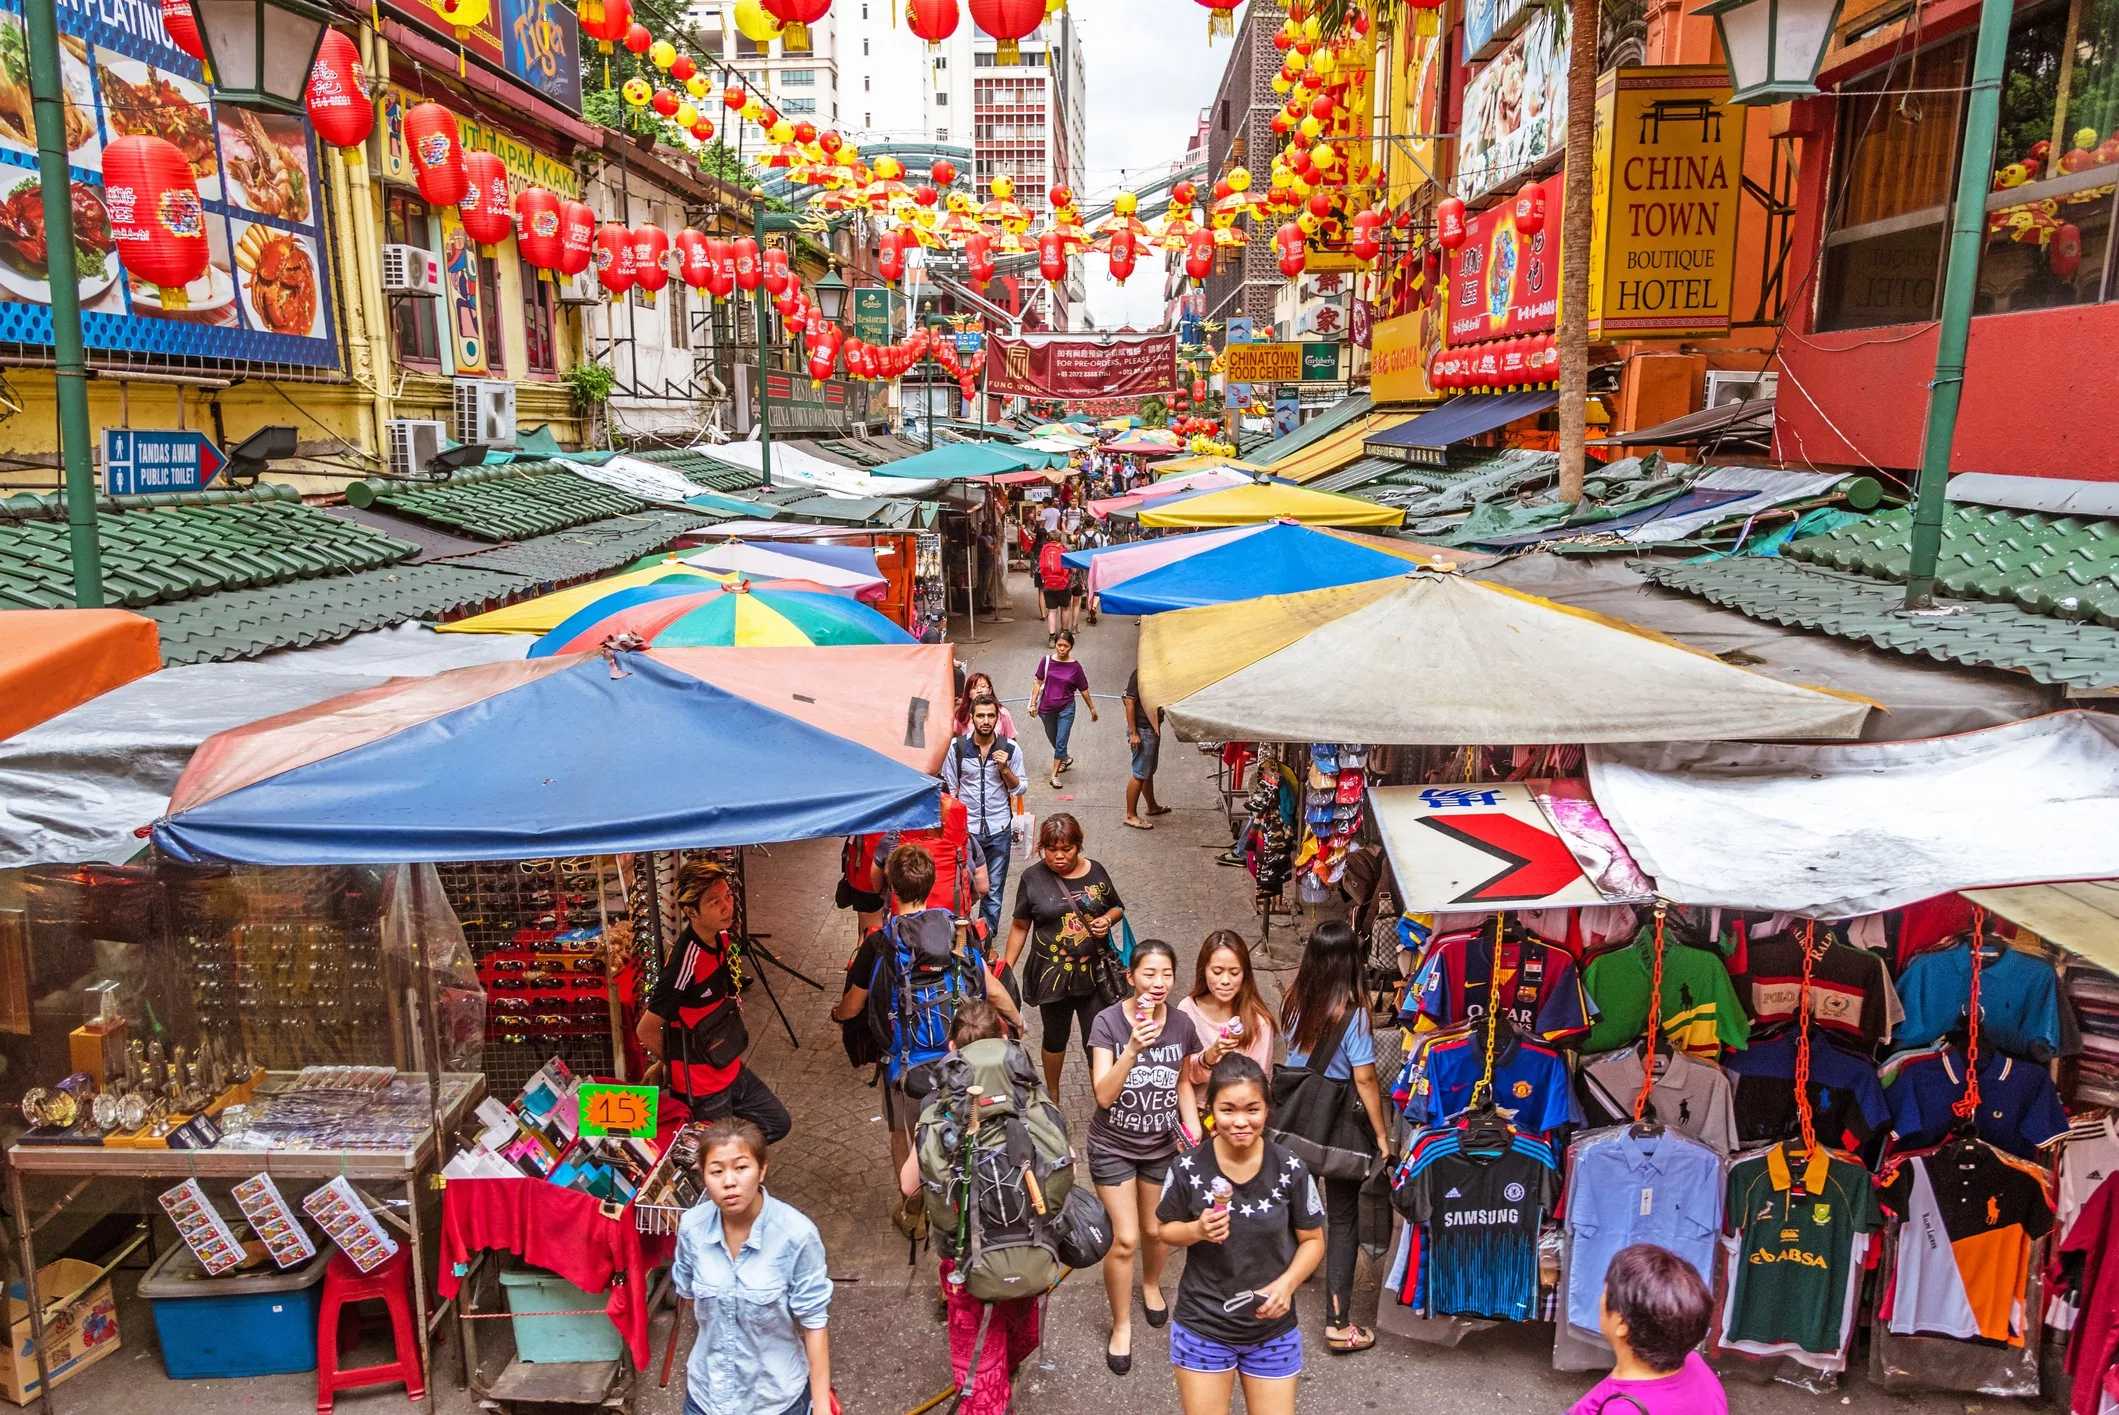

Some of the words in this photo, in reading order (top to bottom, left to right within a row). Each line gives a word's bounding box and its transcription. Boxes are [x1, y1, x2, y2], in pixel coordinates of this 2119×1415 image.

[514, 8, 567, 77] Tiger
[486, 133, 537, 178] TAPAK
[1623, 155, 1728, 192] CHINA
[1629, 201, 1720, 237] TOWN
[1627, 249, 1715, 271] BOUTIQUE
[1616, 278, 1719, 311] HOTEL
[857, 314, 887, 324] Restoran
[1316, 307, 1341, 332] 家
[862, 325, 882, 335] China
[1124, 356, 1151, 365] PLEASE
[1230, 352, 1299, 366] CHINATOWN
[1304, 355, 1336, 368] Carlsberg
[1229, 366, 1257, 380] FOOD
[1259, 366, 1299, 379] CENTRE
[989, 381, 1013, 389] FUNG
[769, 406, 790, 427] CHINA
[790, 408, 808, 427] TOWN
[137, 443, 169, 463] TANDAS
[172, 443, 196, 463] AWAM
[141, 468, 168, 485] PUBLIC
[171, 467, 195, 485] TOILET
[1763, 991, 1796, 1004] POLO
[1149, 1043, 1183, 1063] WITH
[599, 1098, 636, 1123] 15
[1444, 1208, 1519, 1228] SAMSUNG
[1776, 1248, 1828, 1269] ABSA
